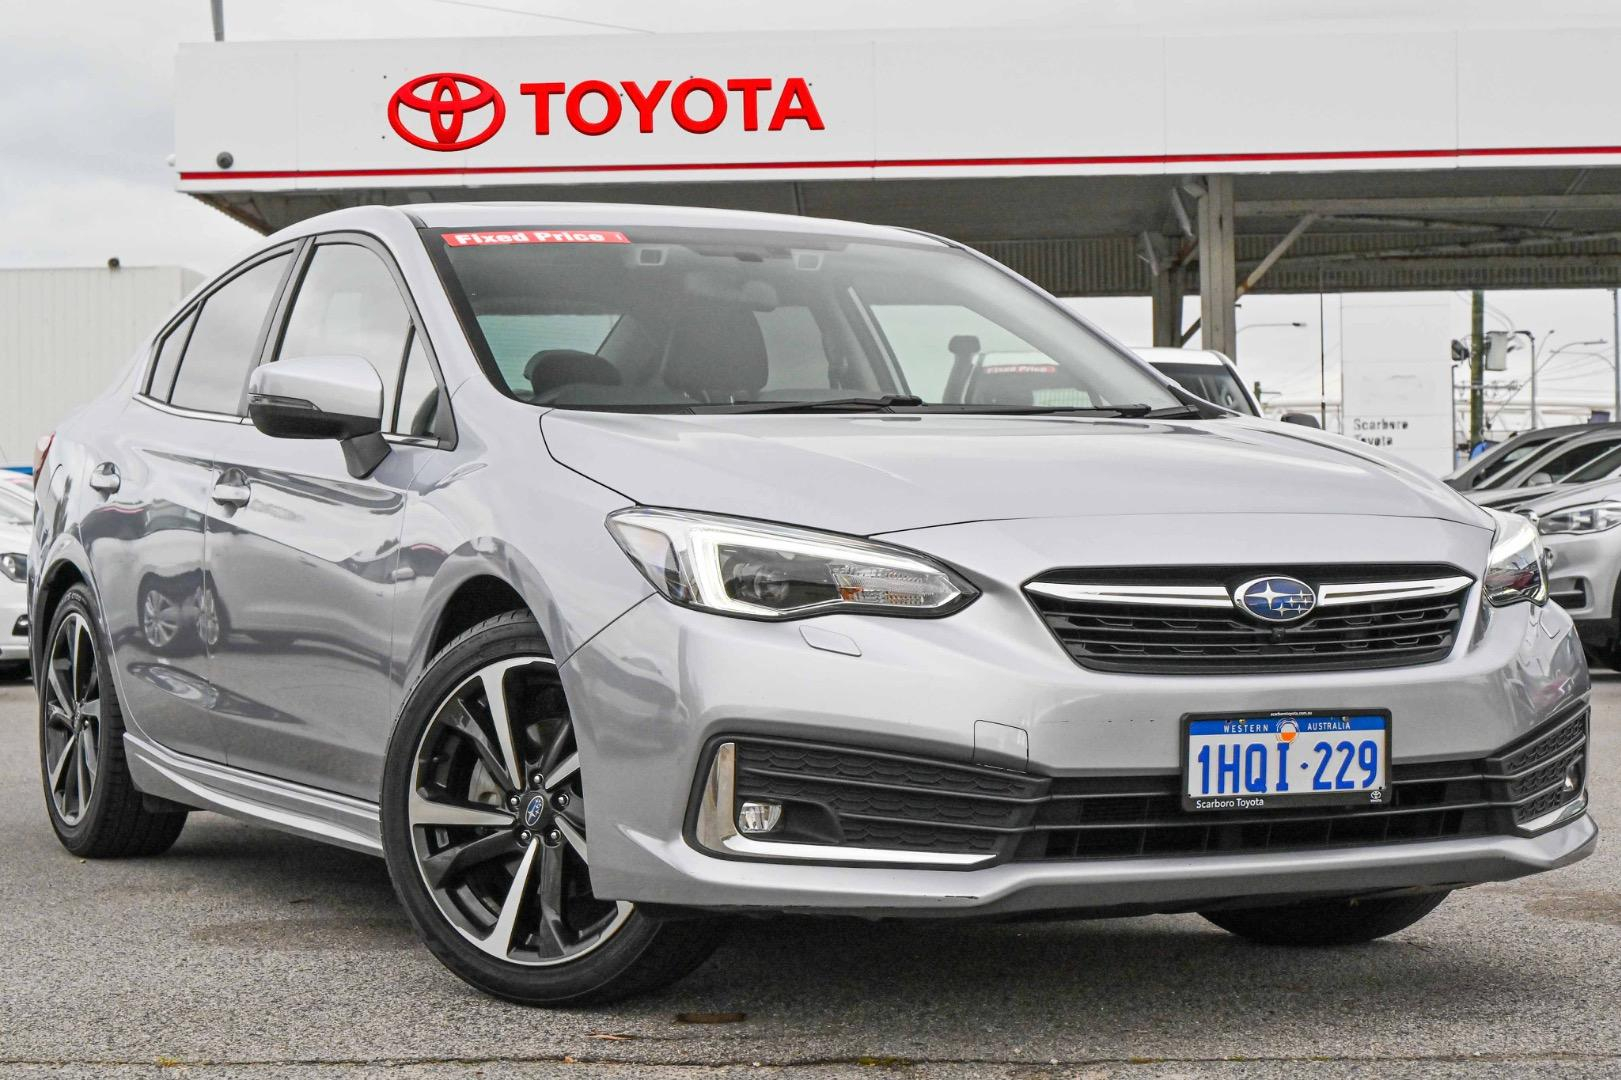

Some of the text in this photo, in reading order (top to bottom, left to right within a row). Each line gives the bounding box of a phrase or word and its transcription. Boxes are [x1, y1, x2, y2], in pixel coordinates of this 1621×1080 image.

[520, 77, 825, 136] TOYOTA
[455, 231, 605, 244] Fixed Price
[1223, 721, 1351, 733] WESTERN AUSTRALIA
[1196, 798, 1264, 809] Scarboro Toyota
